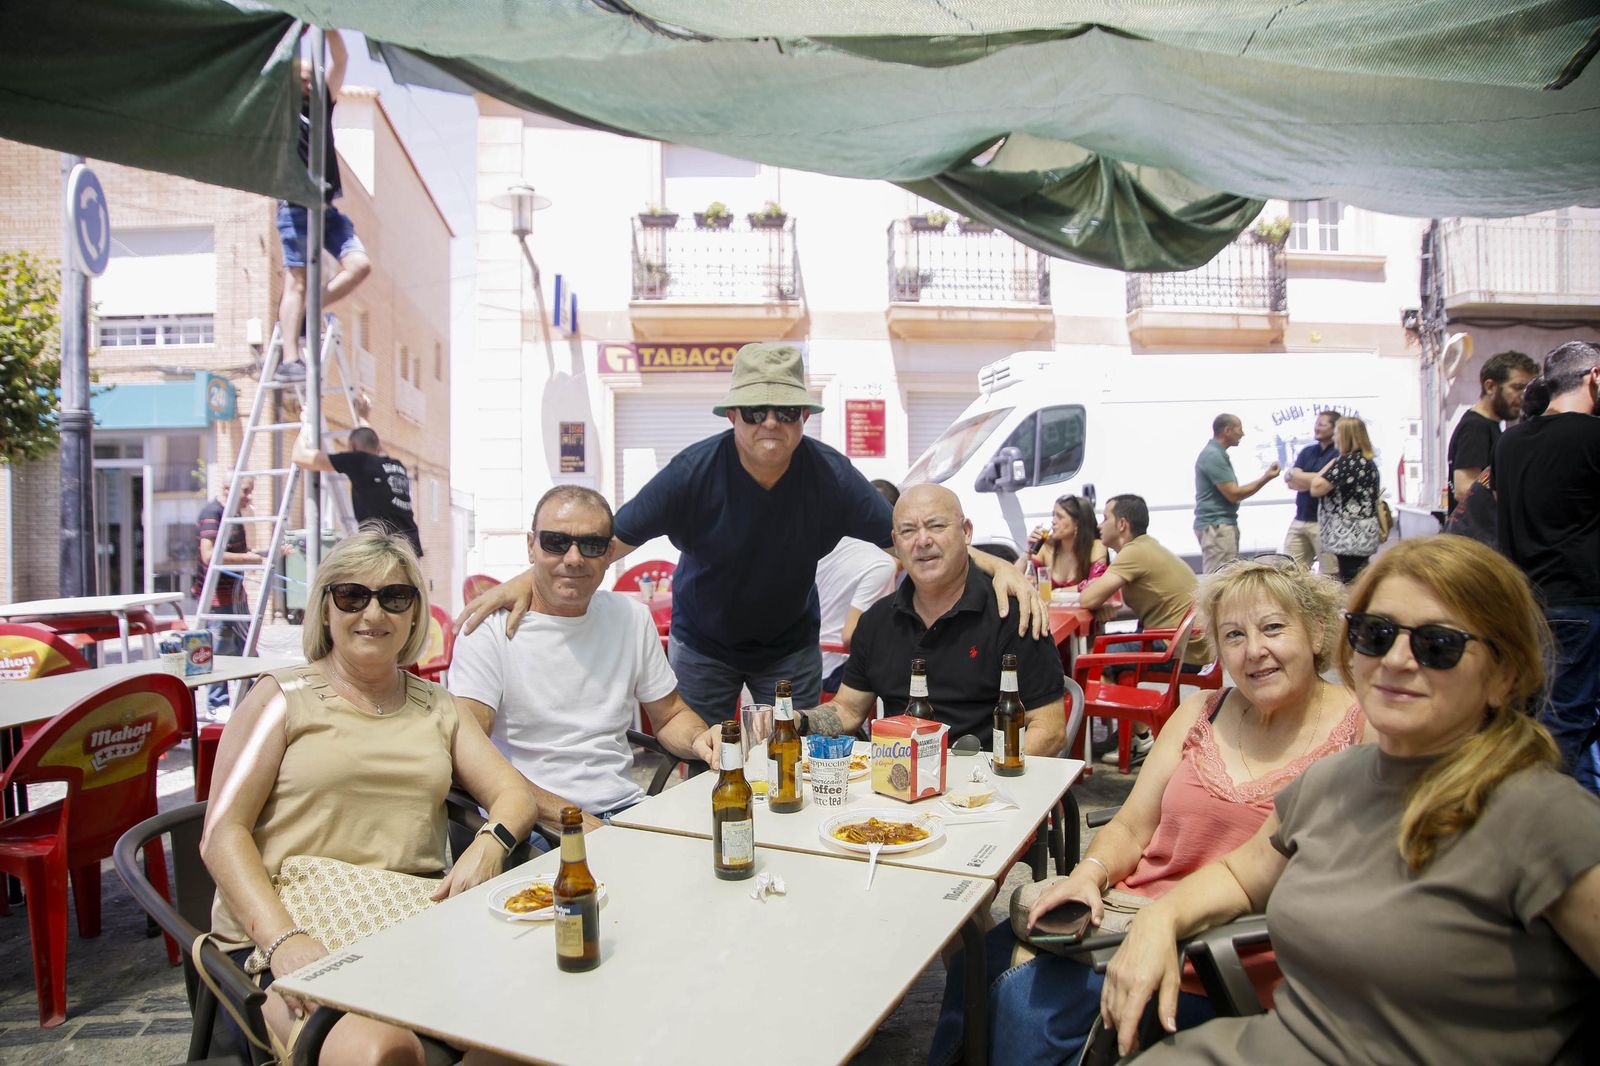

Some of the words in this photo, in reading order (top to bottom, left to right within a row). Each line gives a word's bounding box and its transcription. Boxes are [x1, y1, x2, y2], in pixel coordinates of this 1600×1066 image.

[638, 347, 737, 366] TABACO
[0, 655, 35, 670] ahou
[90, 721, 153, 748] Mahou
[871, 741, 912, 760] ColaCao
[809, 760, 849, 768] appuccino
[829, 796, 842, 807] tea
[942, 879, 973, 901] Mahou
[301, 954, 364, 981] Mahou
